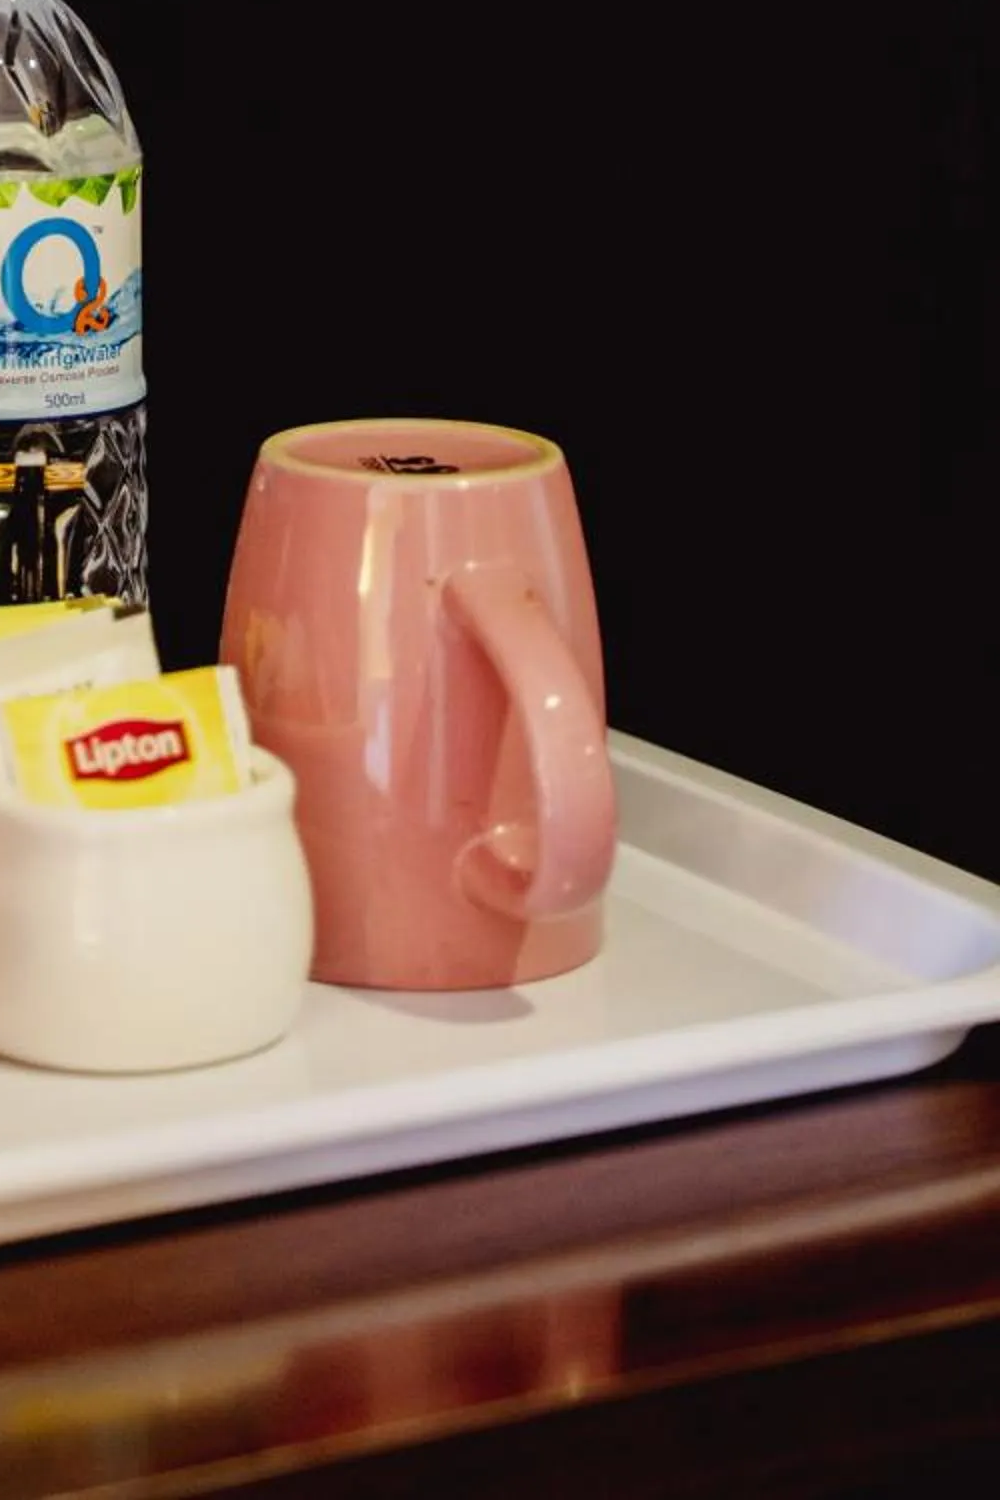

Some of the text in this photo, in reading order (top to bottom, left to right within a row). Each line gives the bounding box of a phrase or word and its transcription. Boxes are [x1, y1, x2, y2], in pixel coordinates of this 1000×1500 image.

[79, 342, 121, 362] Water
[44, 392, 87, 409] 500ml
[74, 730, 184, 776] Lipton
